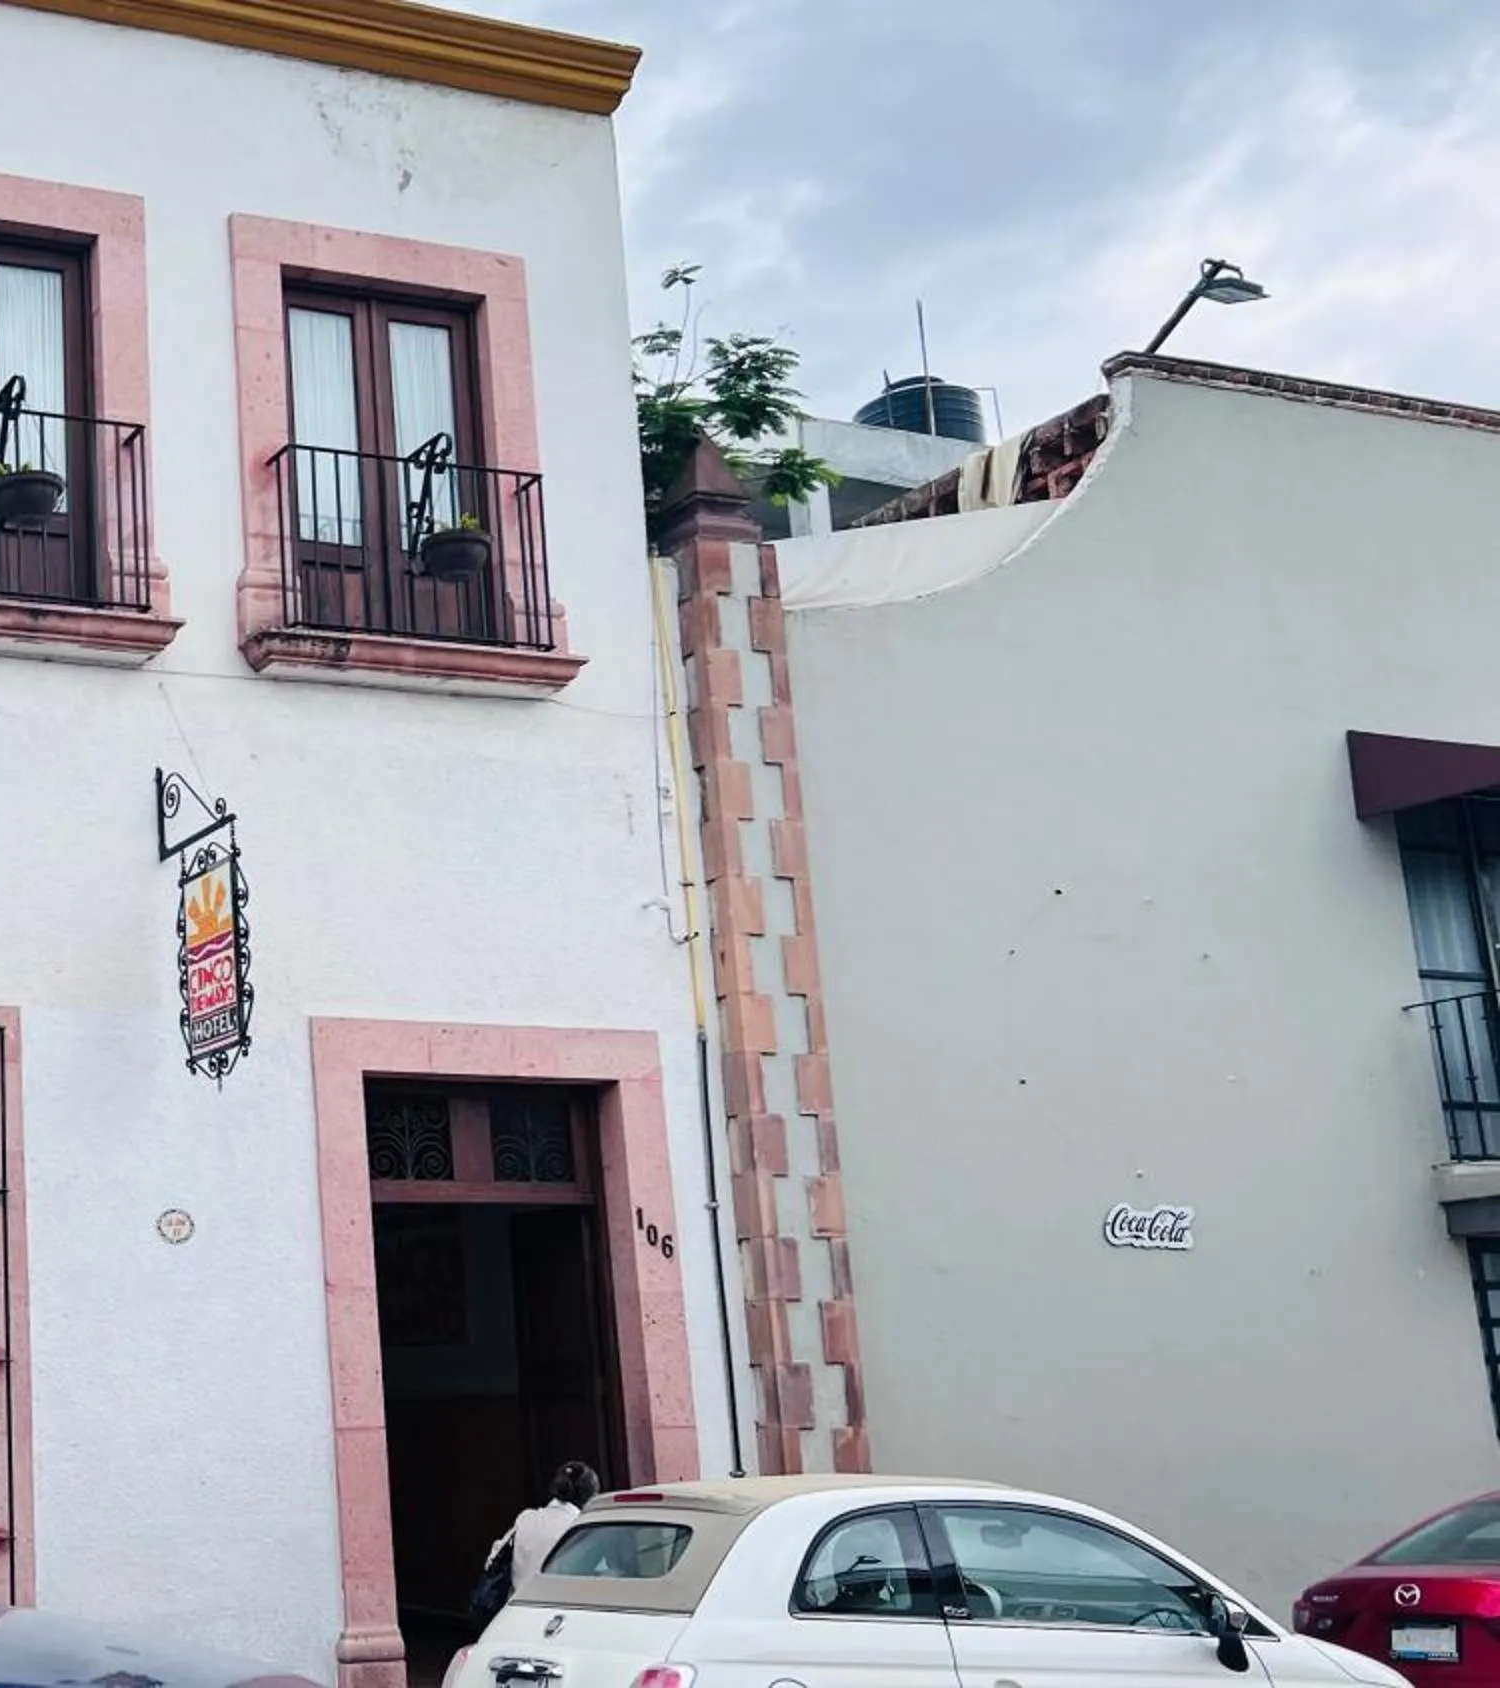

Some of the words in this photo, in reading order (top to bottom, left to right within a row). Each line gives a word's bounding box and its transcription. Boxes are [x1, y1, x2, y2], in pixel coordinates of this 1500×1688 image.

[190, 956, 233, 994] CINCO
[194, 1011, 234, 1041] HOTEL
[636, 1207, 673, 1259] 106
